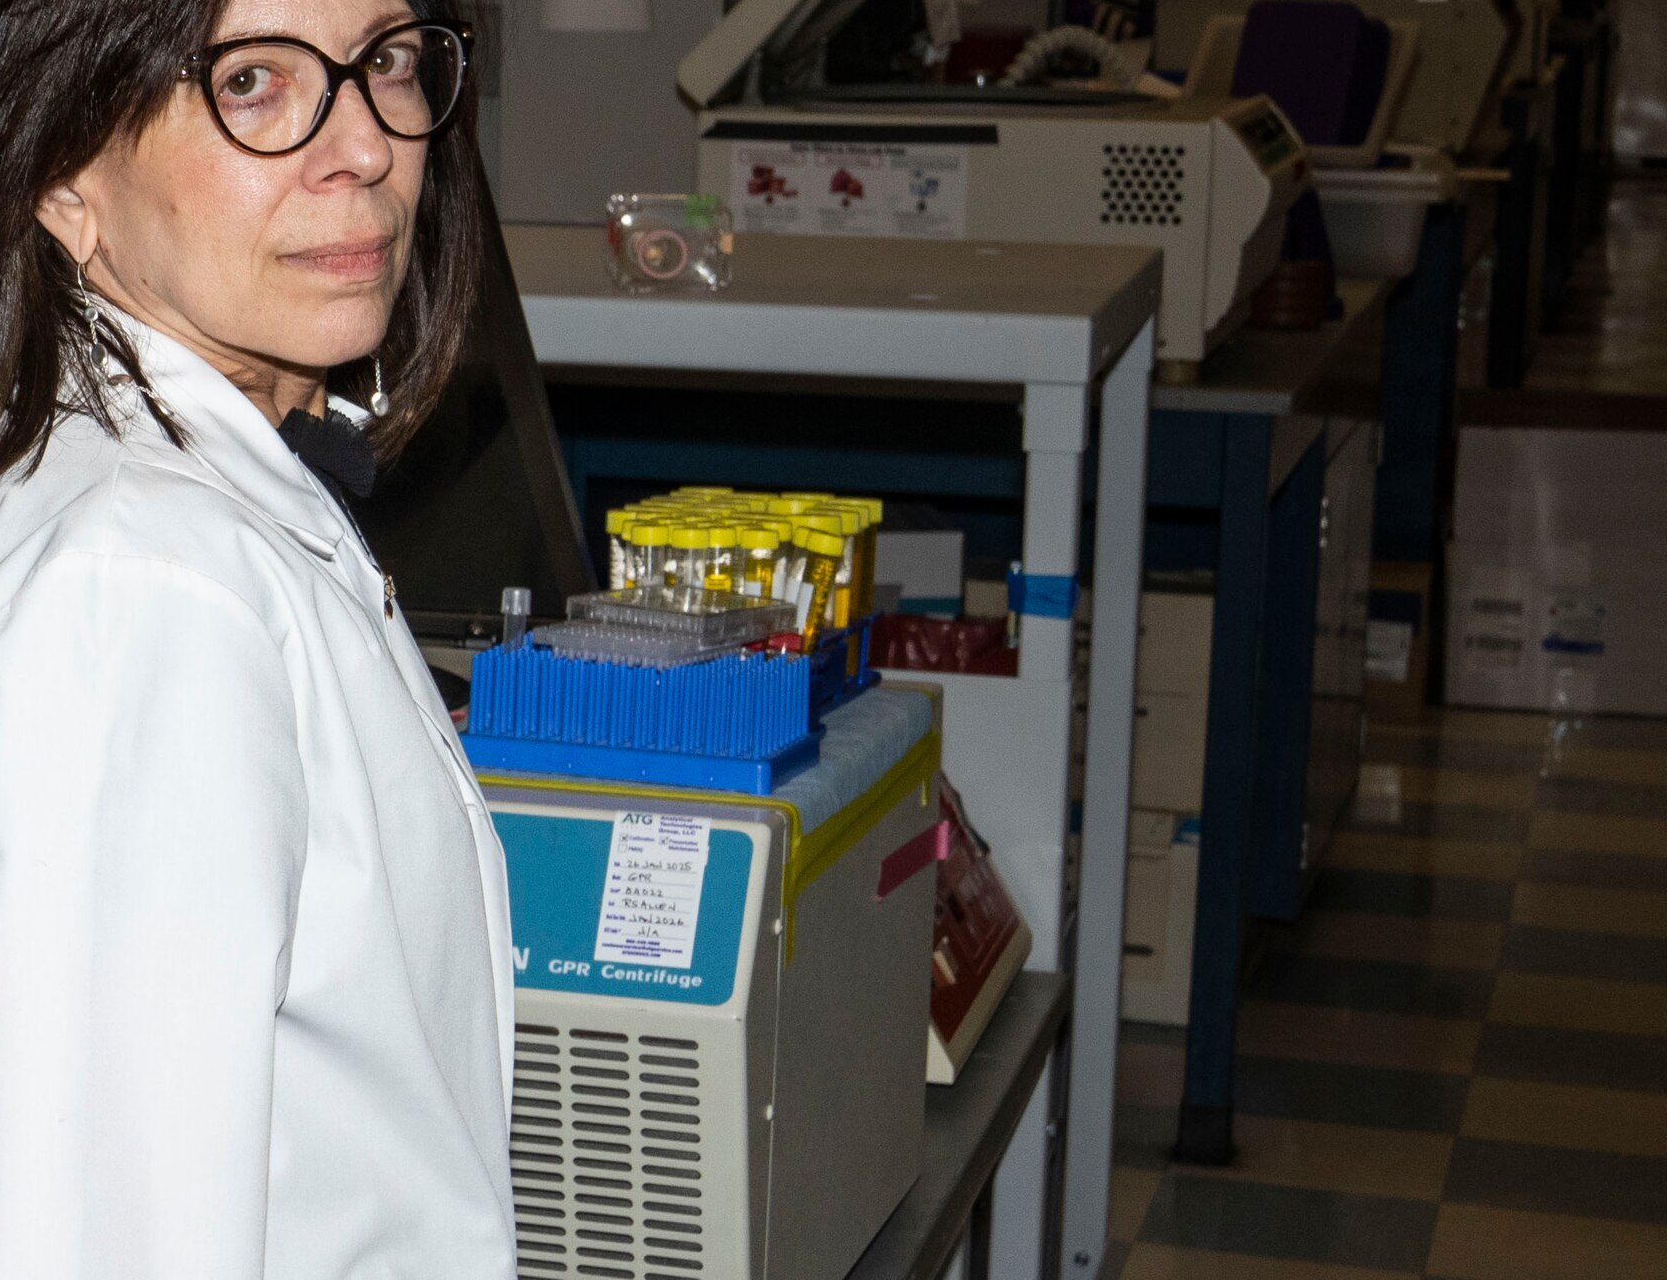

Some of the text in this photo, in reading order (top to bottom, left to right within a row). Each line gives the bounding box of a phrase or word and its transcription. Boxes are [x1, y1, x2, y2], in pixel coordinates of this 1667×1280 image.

[622, 813, 653, 825] ATG
[548, 958, 591, 977] GPR
[601, 964, 703, 989] Centrifuge
